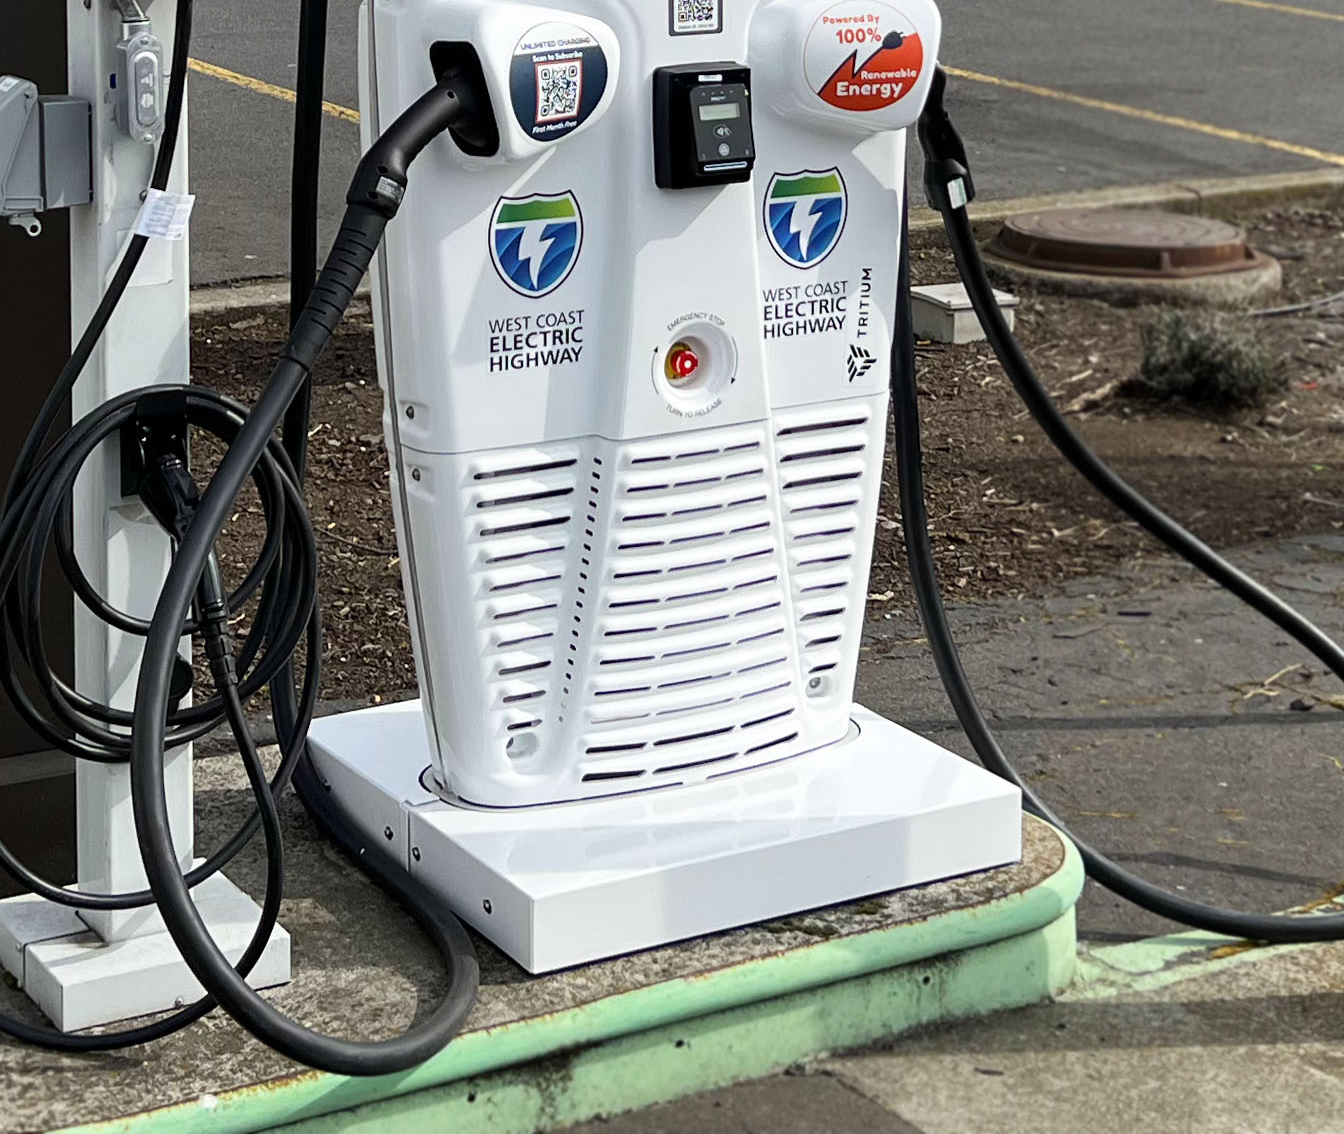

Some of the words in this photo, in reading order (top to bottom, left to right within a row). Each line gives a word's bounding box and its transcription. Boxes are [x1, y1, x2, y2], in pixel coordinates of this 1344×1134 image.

[823, 15, 864, 24] Powered
[867, 14, 879, 24] By
[520, 40, 556, 51] UNLIMITED
[836, 27, 881, 44] 100%
[861, 68, 917, 80] Renewable
[836, 81, 903, 98] Energy
[762, 286, 801, 303] WEST
[804, 280, 848, 298] COAST
[857, 267, 872, 338] TRITIUM
[763, 296, 847, 321] ELECTRIC
[489, 315, 531, 334] WEST
[536, 309, 585, 328] COAST
[666, 312, 708, 332] EMERGENCY
[708, 312, 726, 326] STOP
[763, 315, 846, 339] HIGHWAY
[490, 326, 583, 353] ELECTRIC
[490, 346, 583, 373] HIGHWAY
